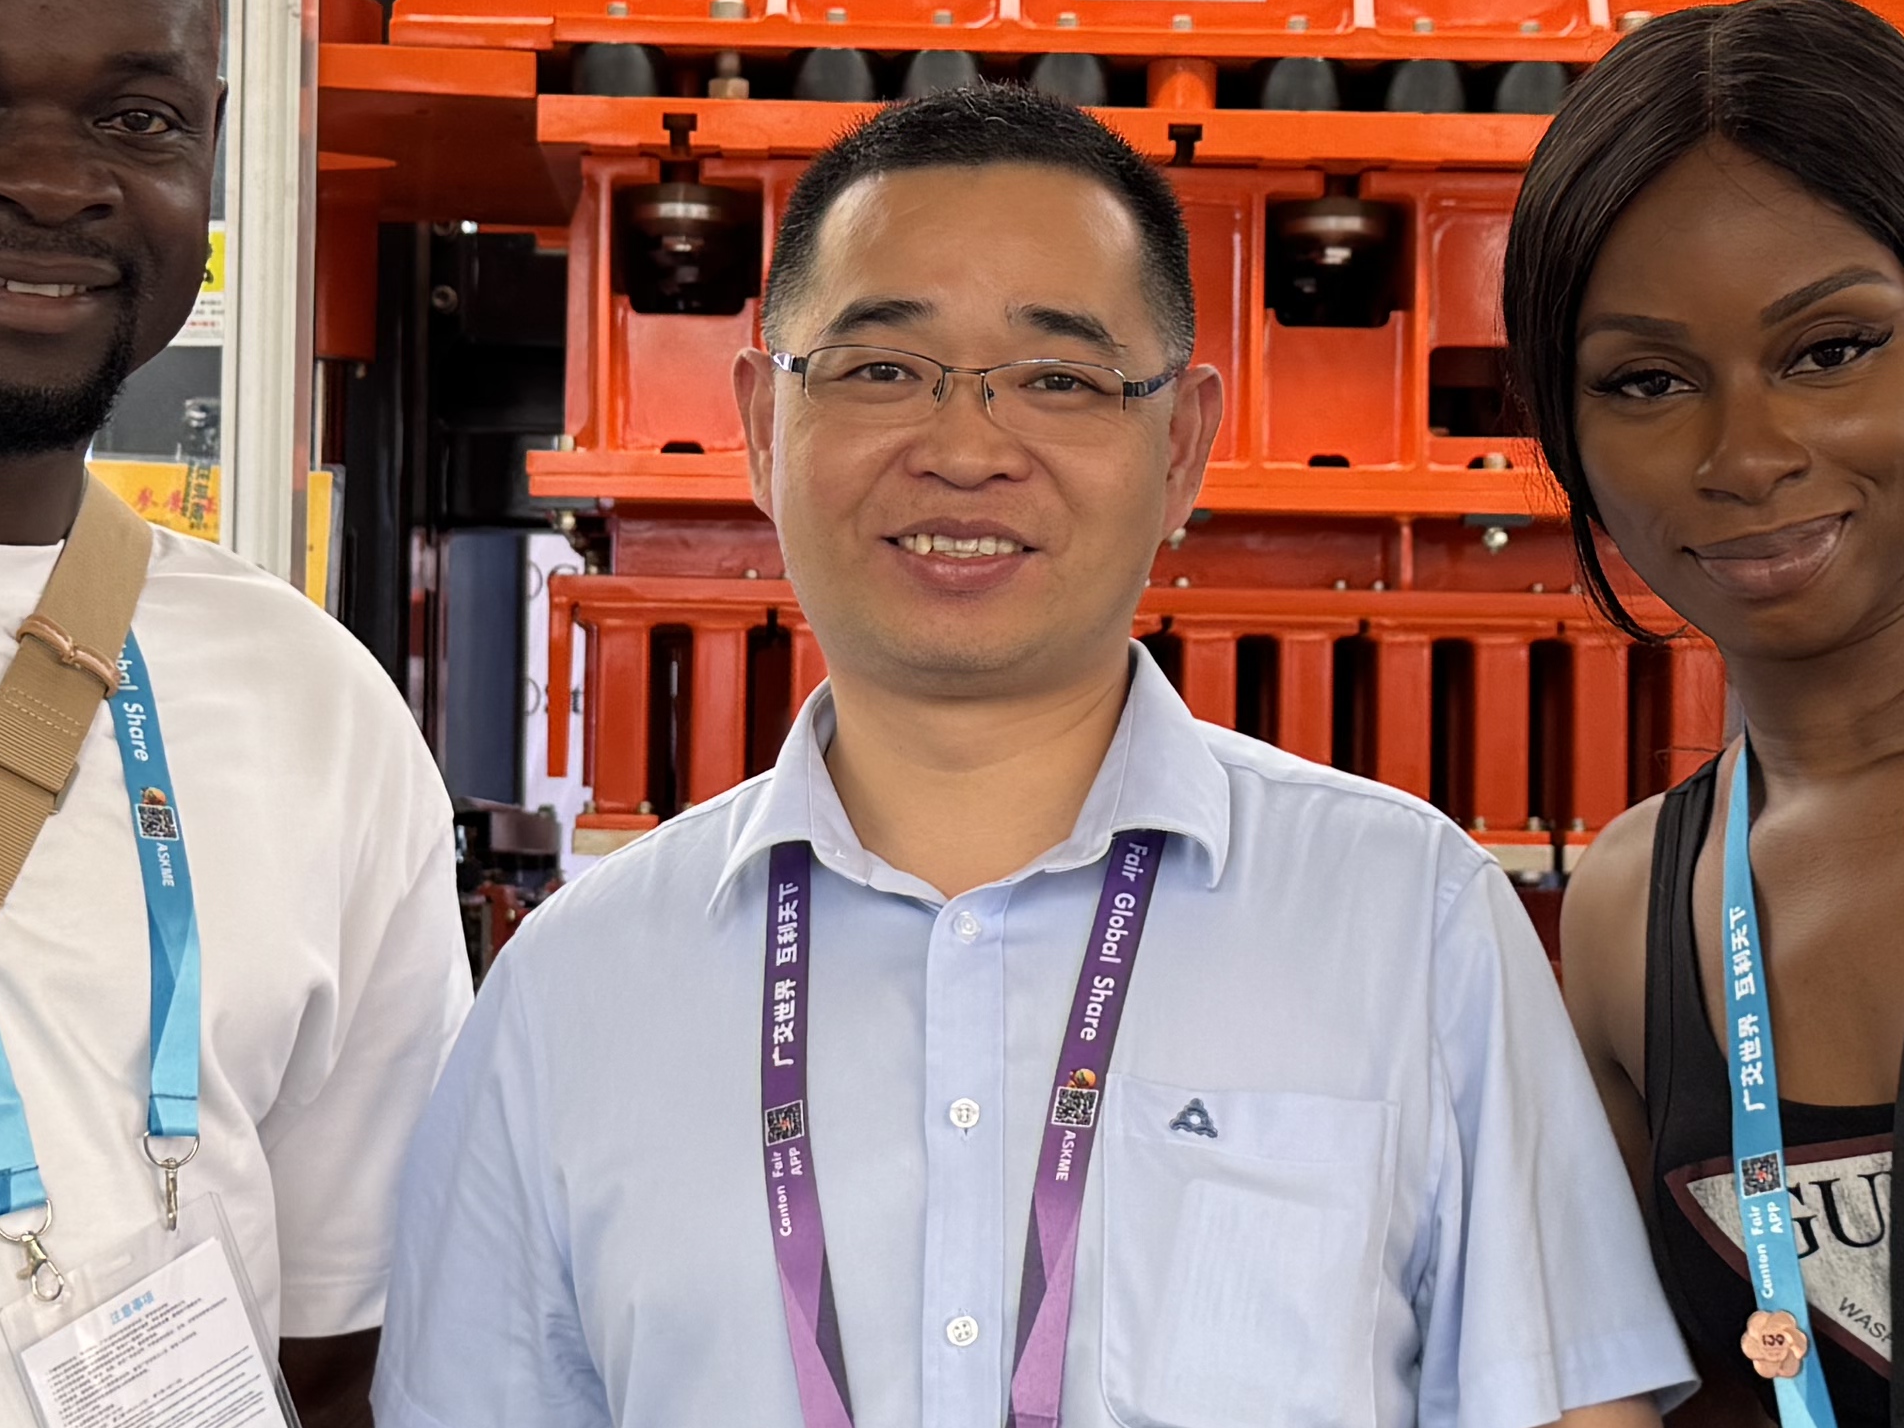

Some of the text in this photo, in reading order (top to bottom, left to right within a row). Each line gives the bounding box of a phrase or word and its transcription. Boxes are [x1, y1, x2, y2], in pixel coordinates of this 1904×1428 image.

[123, 702, 149, 762] Share
[156, 842, 174, 887] ASKME
[1080, 841, 1148, 1042] Fair Global Share
[772, 882, 799, 1067] 广交世界 互利天下
[1729, 907, 1766, 1111] 广交世界 互利天下
[789, 1147, 804, 1175] APP
[1055, 1130, 1077, 1182] ASKME
[772, 1151, 793, 1237] Canton Fair
[1769, 1201, 1784, 1234] APP
[1750, 1205, 1775, 1299] Canton Fair
[107, 1289, 156, 1326] 注意事项
